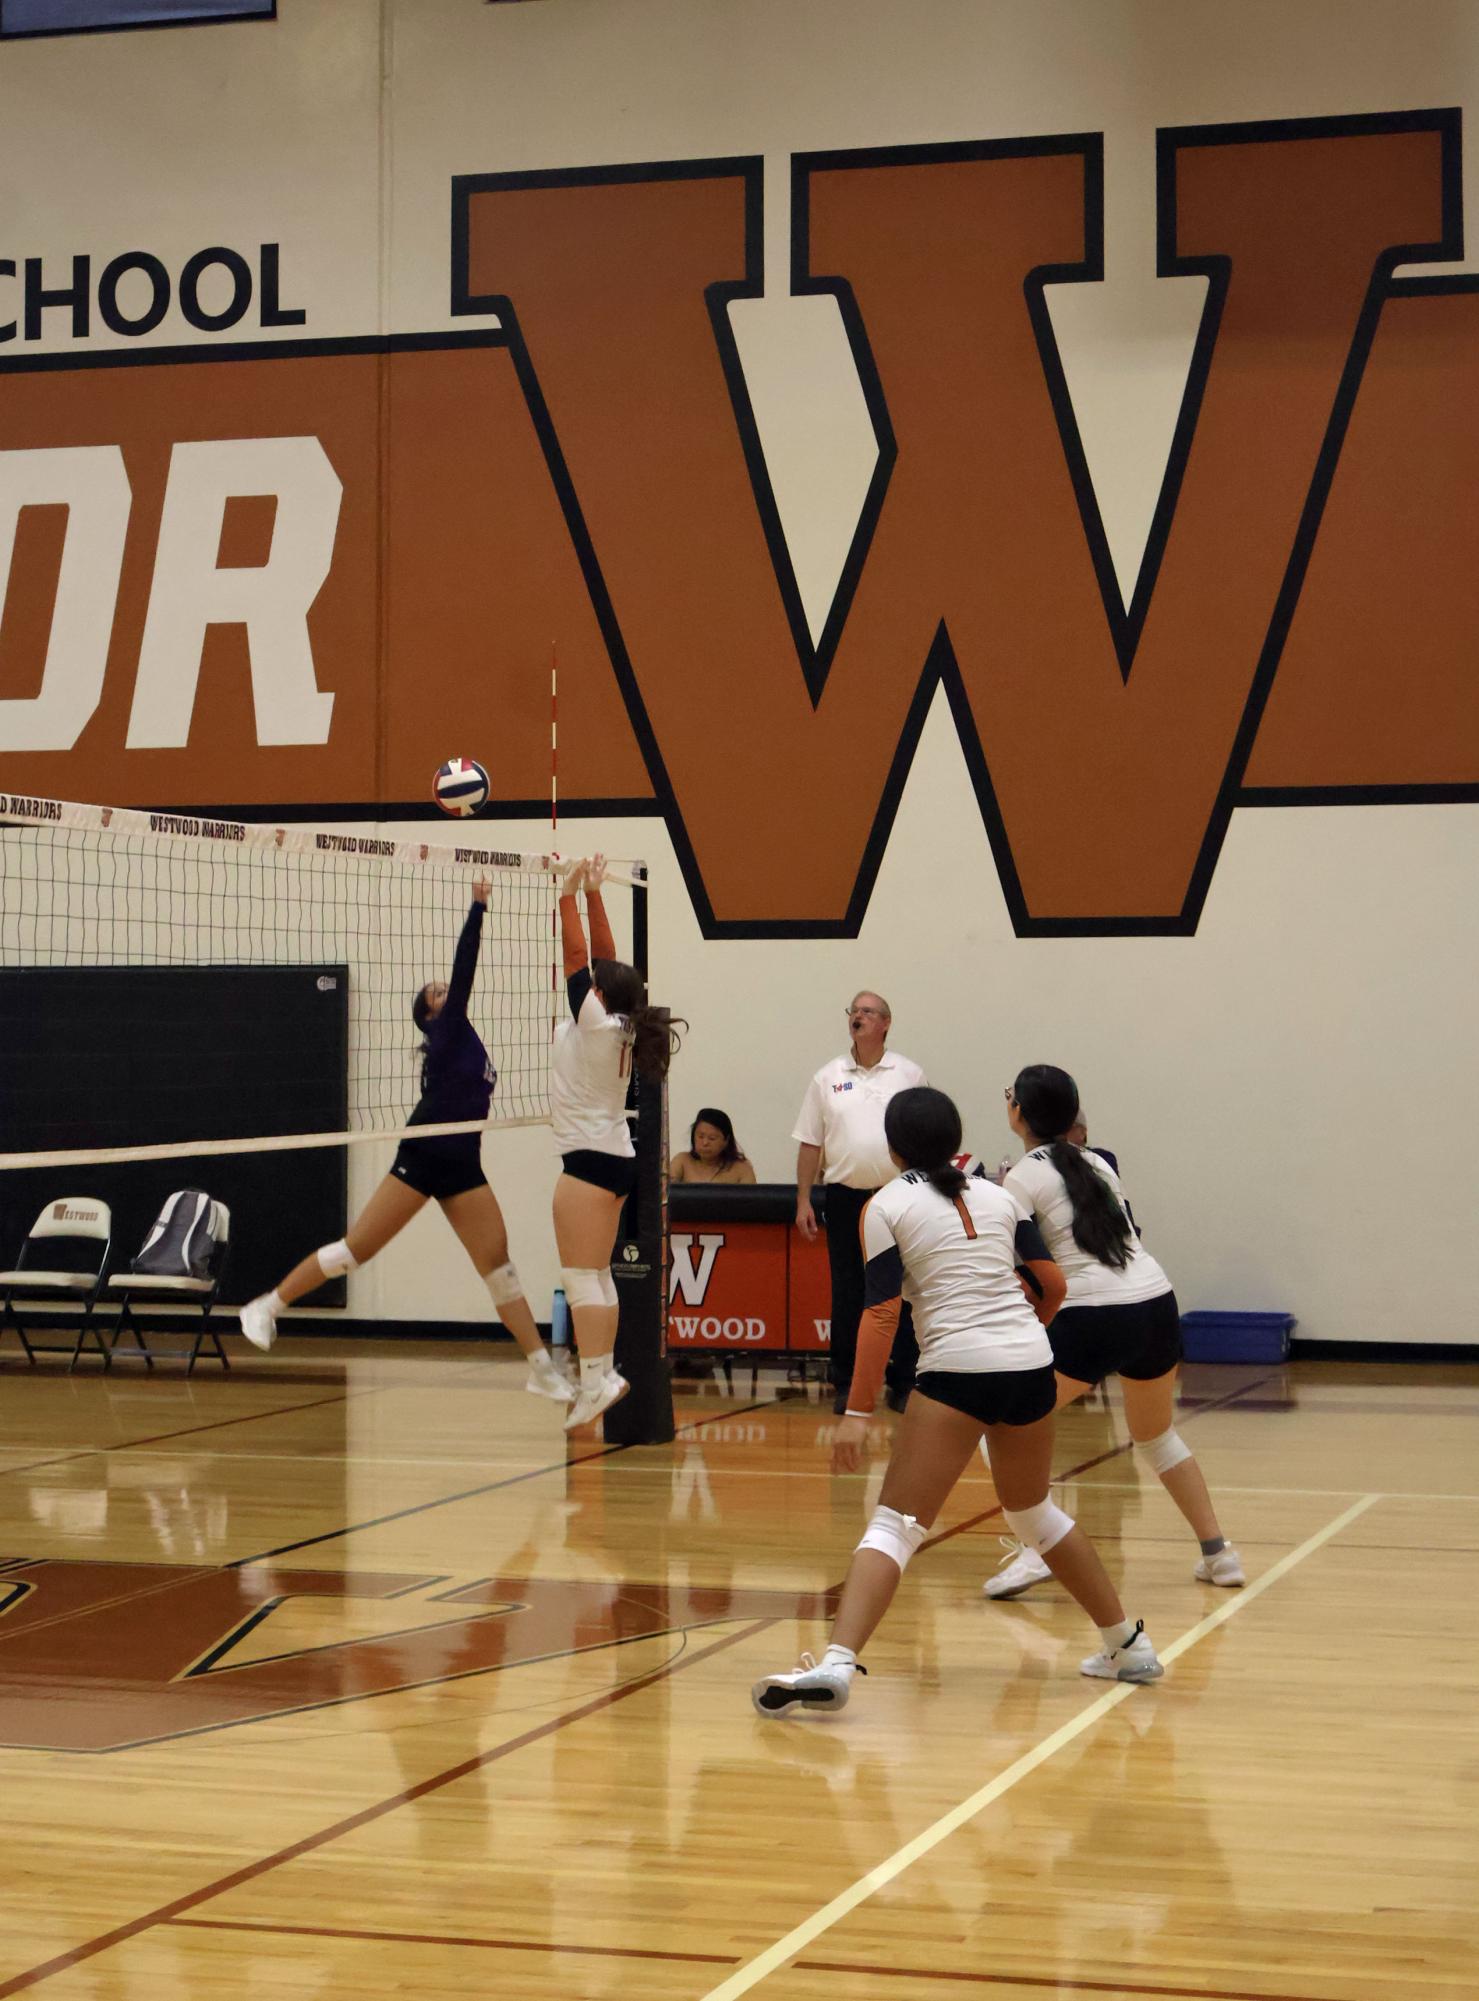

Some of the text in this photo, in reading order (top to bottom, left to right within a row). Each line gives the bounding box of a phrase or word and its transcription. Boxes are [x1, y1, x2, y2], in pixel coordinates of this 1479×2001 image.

[451, 106, 1465, 940] W
[10, 797, 62, 821] WARRIORS
[668, 1315, 766, 1341] WOOD
